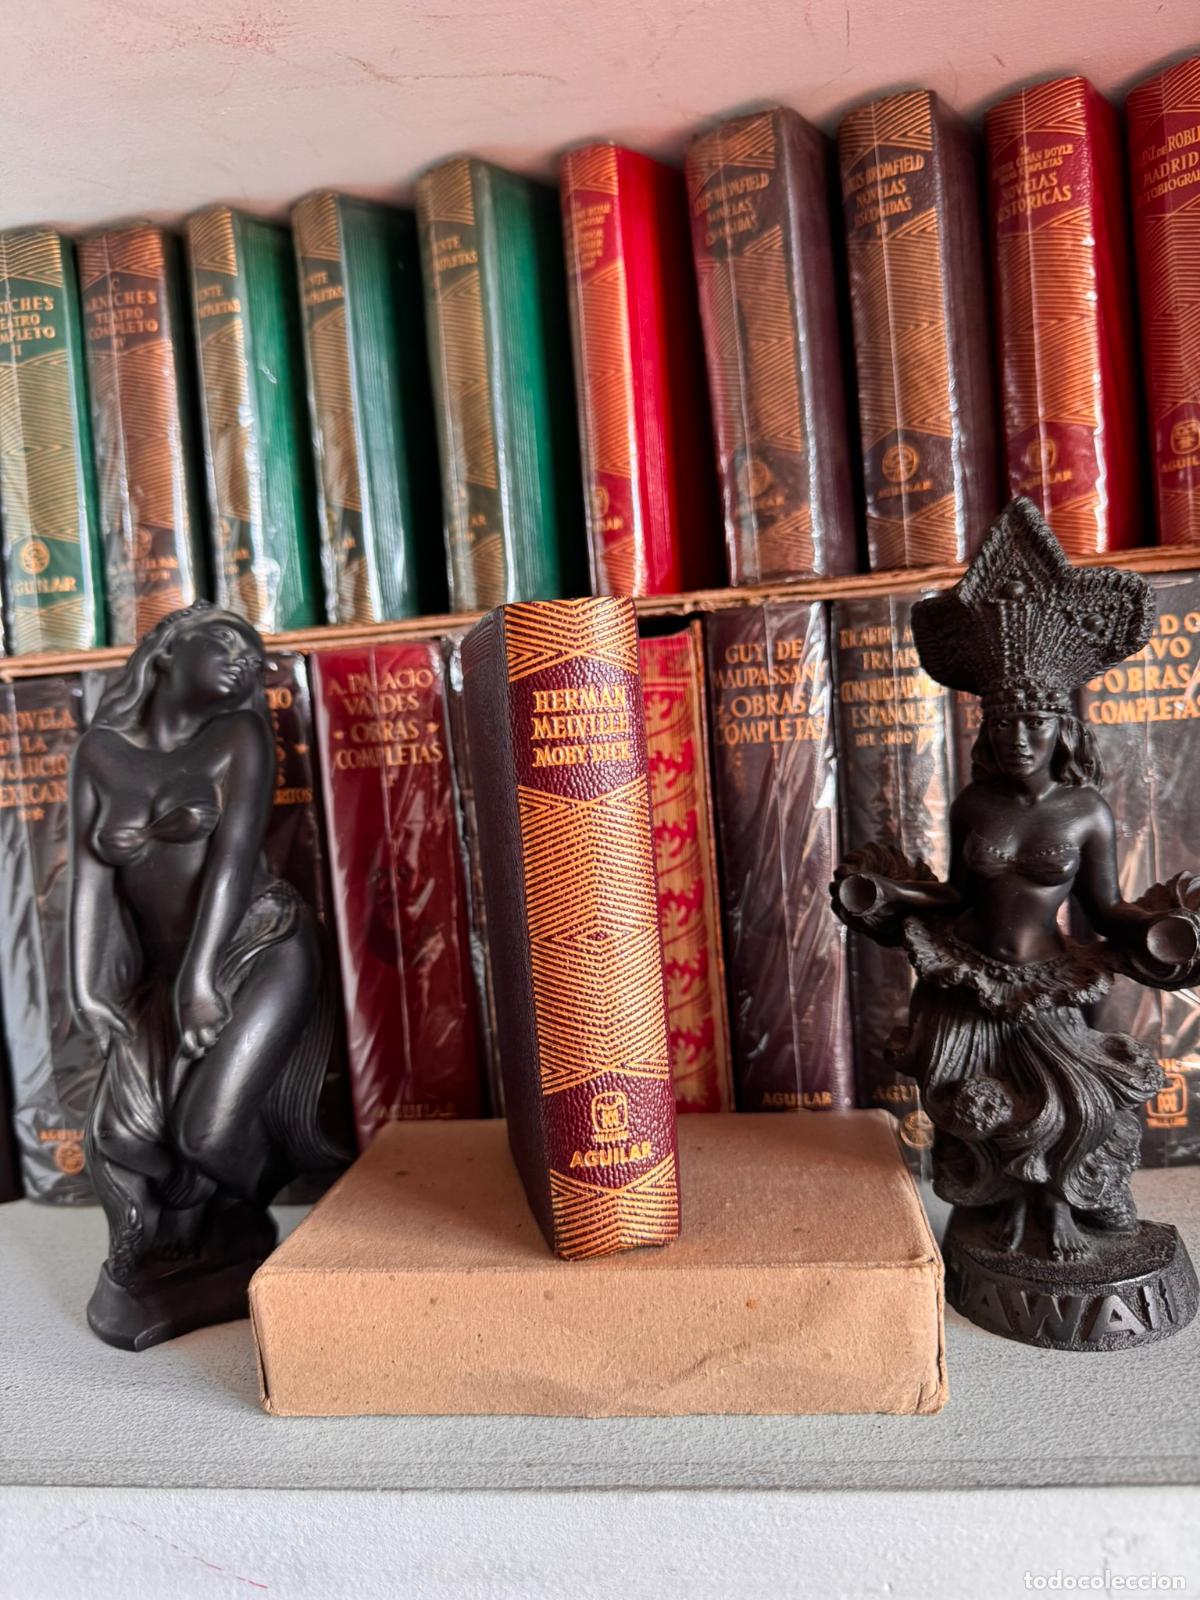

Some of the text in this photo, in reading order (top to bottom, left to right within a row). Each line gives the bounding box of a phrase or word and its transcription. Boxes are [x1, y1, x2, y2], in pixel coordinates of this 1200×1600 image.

[1045, 144, 1074, 159] DOYLE
[725, 638, 803, 665] GUY DE
[1104, 663, 1191, 694] OBRAS
[533, 684, 627, 713] HERMAN
[731, 690, 807, 718] OBRAS
[350, 719, 420, 742] OBRAS
[531, 711, 631, 740] MELVILLE
[21, 735, 48, 754] LA
[336, 740, 443, 770] COMPLETAS
[532, 741, 634, 768] MOBY DICK
[763, 1091, 832, 1107] AGUILAR
[569, 1140, 651, 1168] AGUILAR
[960, 1272, 1179, 1346] AWAII
